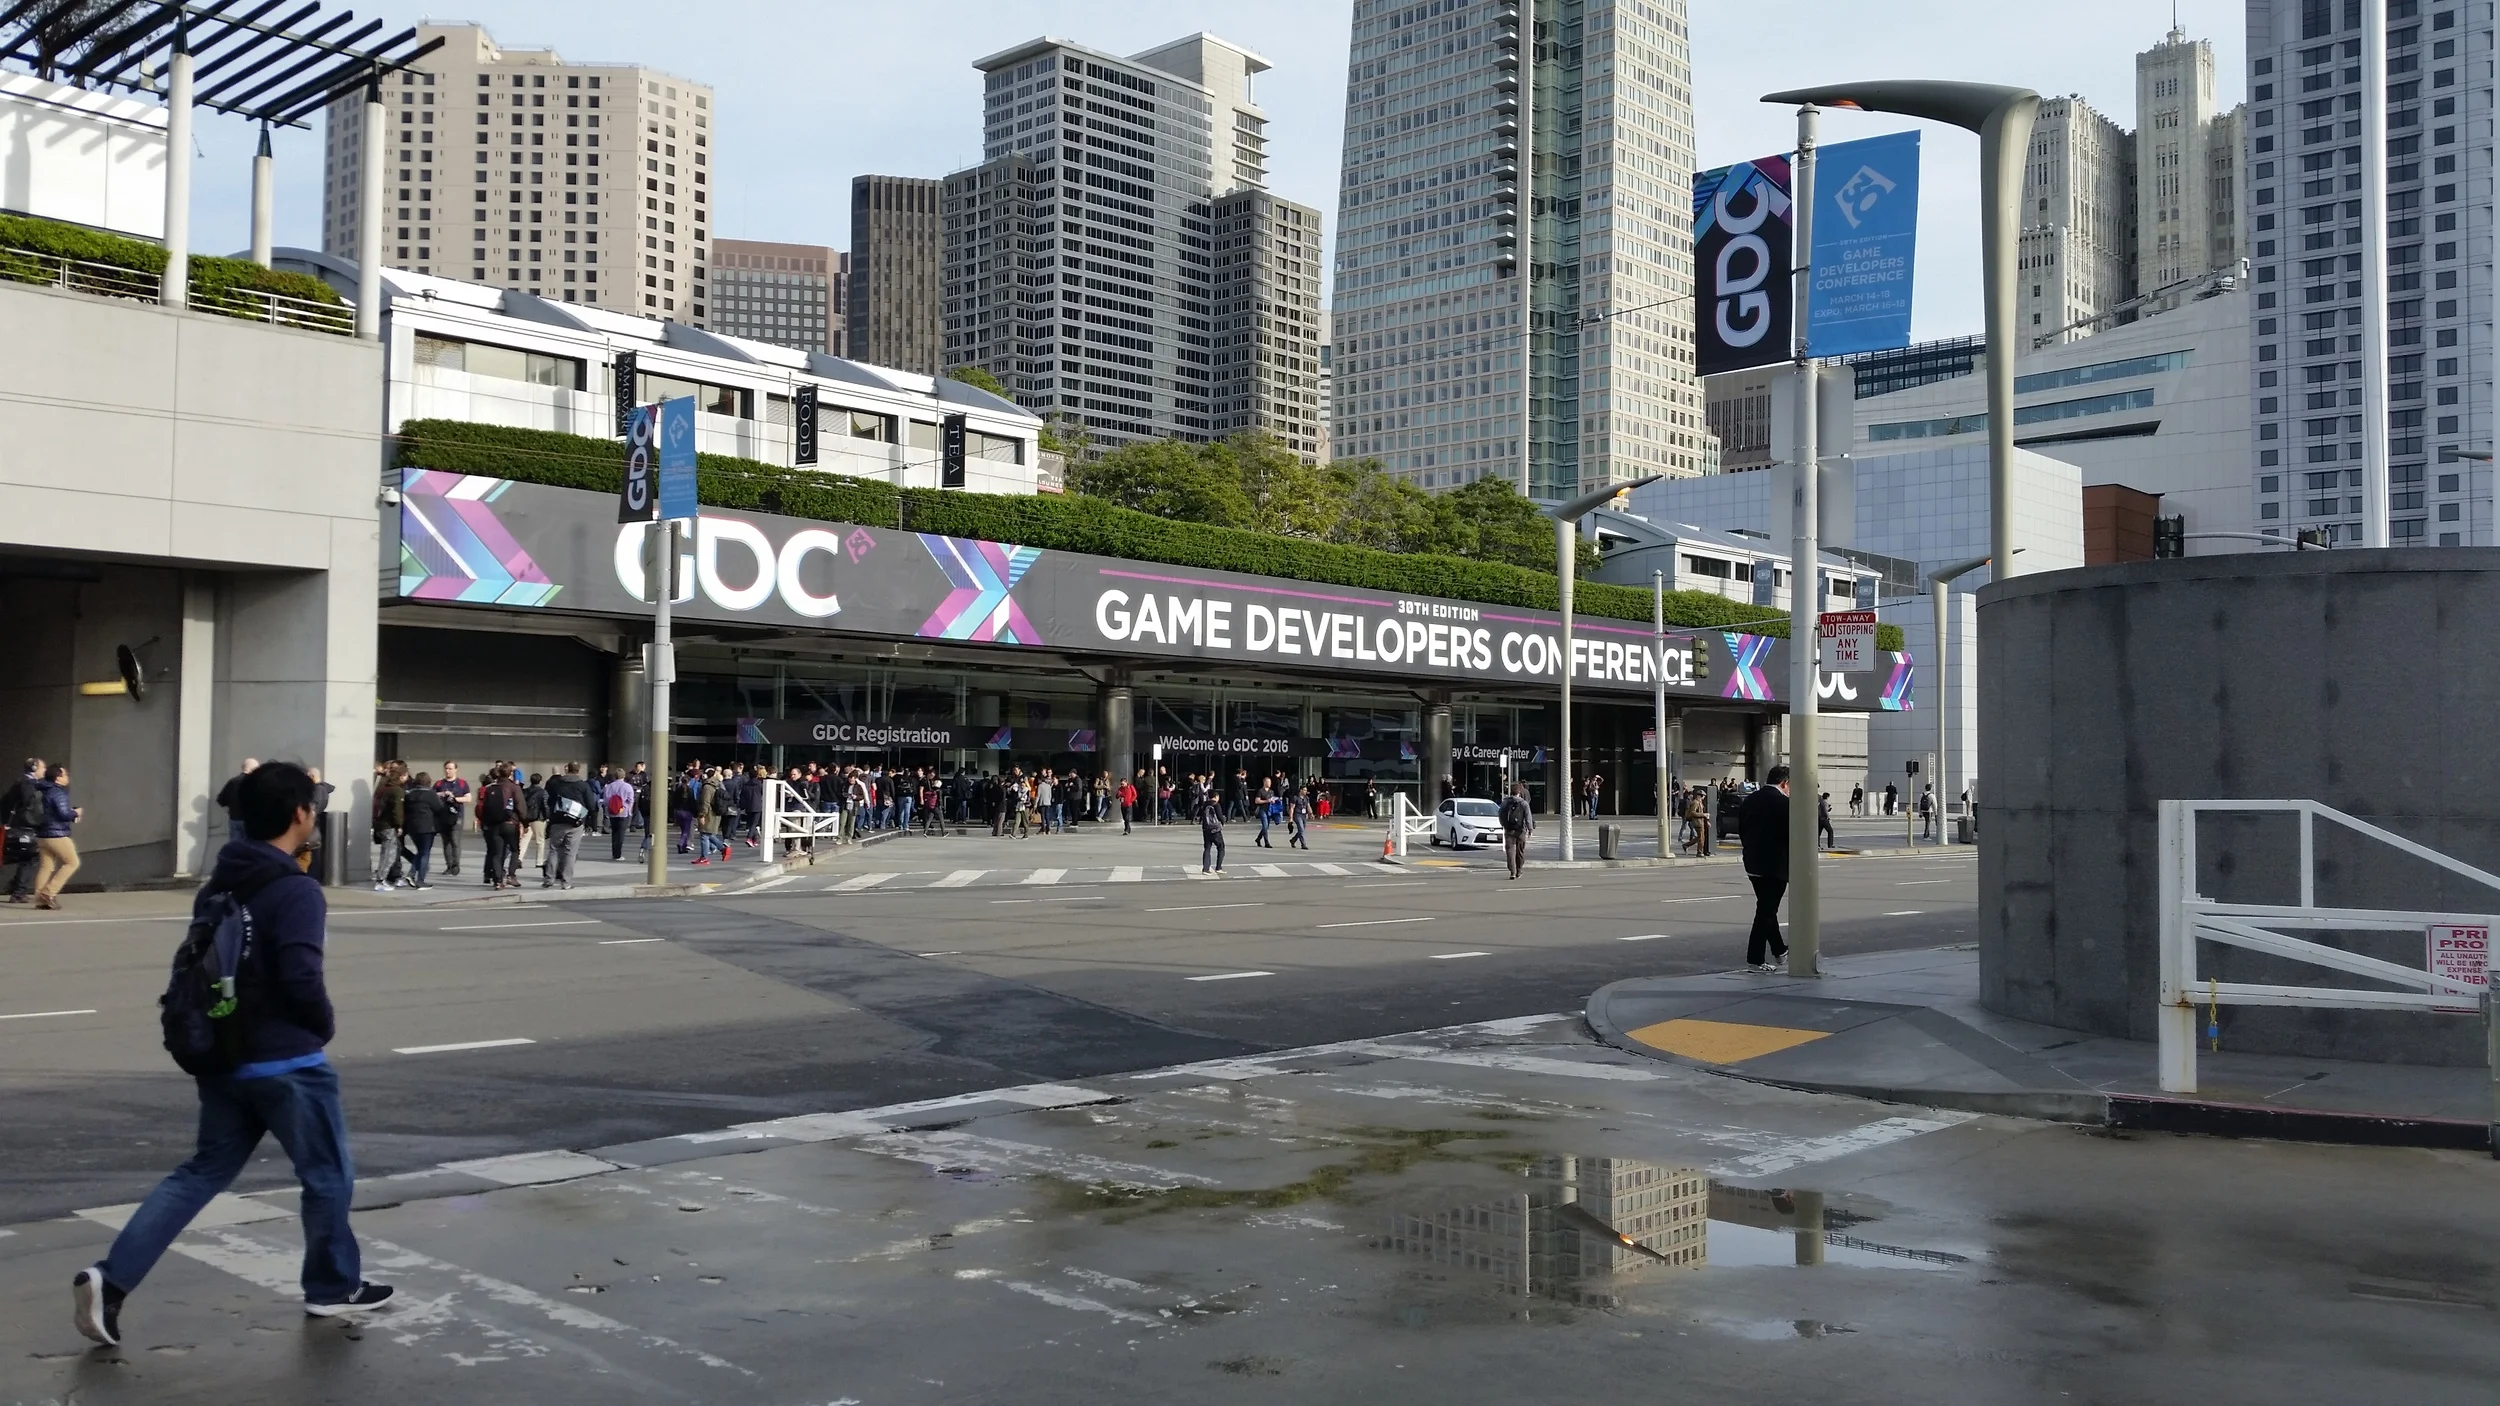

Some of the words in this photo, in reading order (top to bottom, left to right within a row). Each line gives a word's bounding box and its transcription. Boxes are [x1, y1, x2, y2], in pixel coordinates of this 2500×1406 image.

[1843, 246, 1881, 260] GAME
[1714, 180, 1771, 348] GDC
[1820, 257, 1905, 277] DEVELOPERS
[1816, 269, 1904, 291] CONFERENCE
[1830, 292, 1864, 305] MARCH
[1845, 302, 1879, 314] MARCH
[800, 391, 812, 457] FOOD
[949, 424, 960, 475] TEA
[627, 418, 652, 511] GDC
[614, 516, 842, 618] GDC
[1398, 600, 1430, 617] 30TH
[1433, 603, 1479, 622] EDITION
[1825, 614, 1871, 622] TOW-AWAY
[1096, 589, 1232, 649] GAME
[1246, 604, 1492, 671] DEVELOPERS
[1501, 631, 1696, 687] CONFERENCE
[1821, 624, 1835, 637] NO
[1838, 624, 1874, 635] STOPPING
[1837, 638, 1858, 648] ANY
[1836, 650, 1859, 660] TIME
[812, 724, 851, 741] GDC
[856, 725, 951, 745] Registration
[1159, 735, 1215, 751] Welcome
[1217, 737, 1230, 751] to
[1232, 738, 1259, 752] GDC
[1262, 739, 1289, 753] 2016
[1452, 747, 1462, 759] ay
[1463, 746, 1470, 757] &
[1472, 746, 1501, 758] Career
[2452, 929, 2487, 939] PRI
[2440, 940, 2487, 949] PRO
